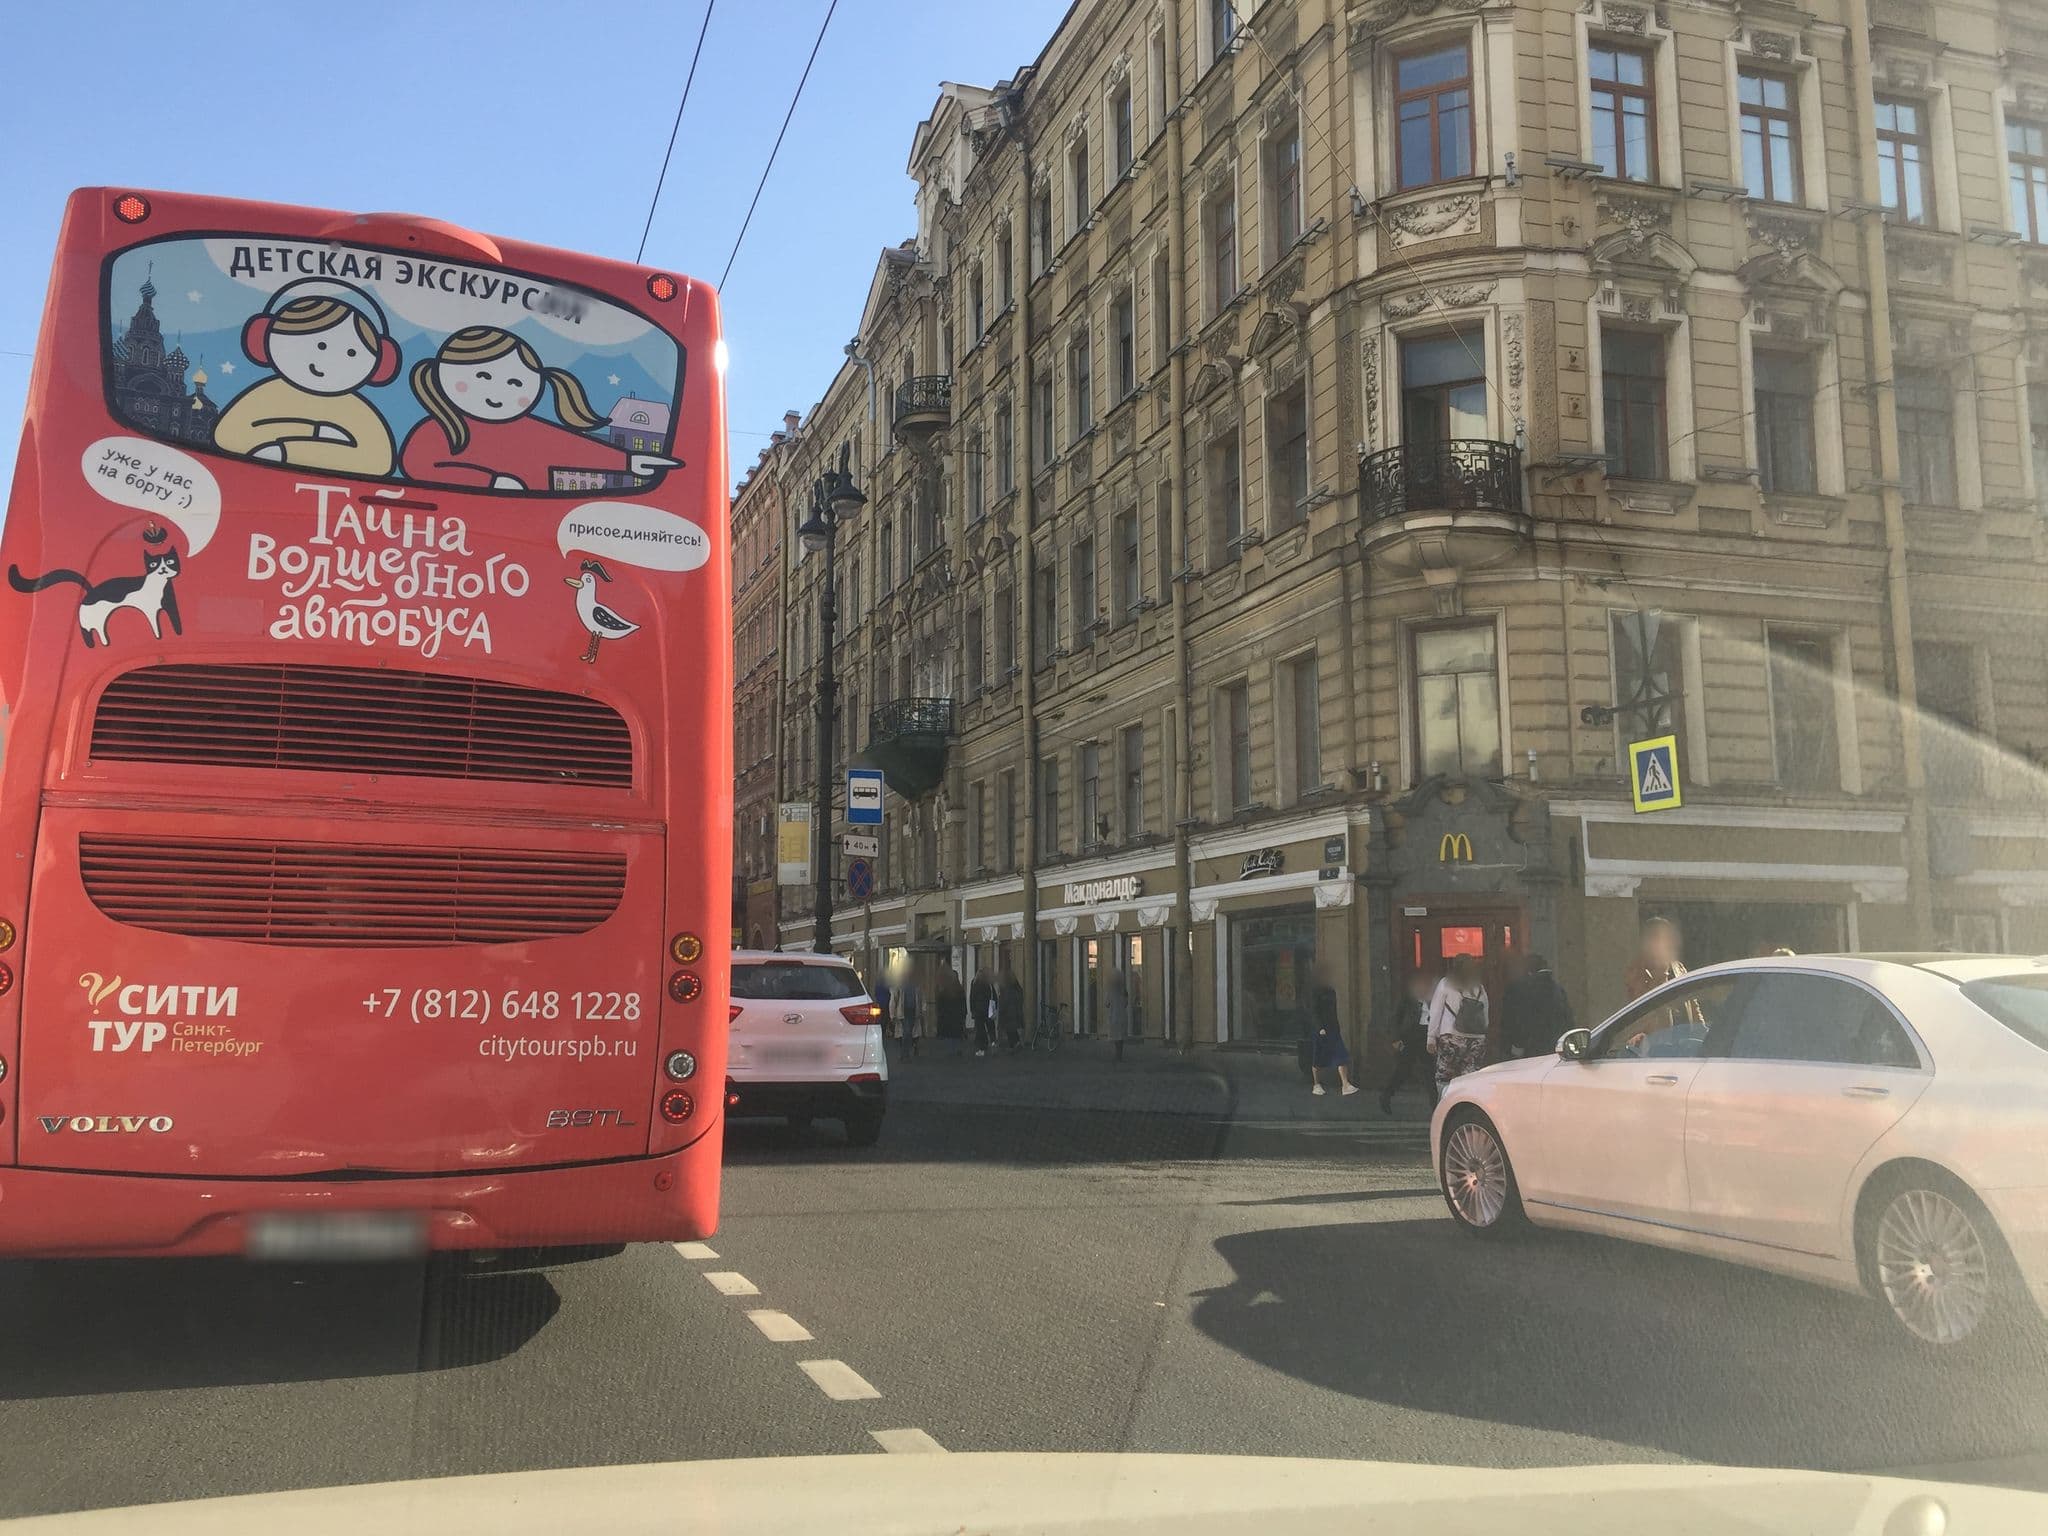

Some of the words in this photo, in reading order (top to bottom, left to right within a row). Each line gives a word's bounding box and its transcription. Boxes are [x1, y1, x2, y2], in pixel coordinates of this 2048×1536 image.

[230, 246, 382, 281] ДЕТСКАЯ
[395, 260, 582, 325] ЭКСКУРС
[97, 464, 118, 479] на
[125, 473, 173, 501] борту
[102, 449, 141, 470] уже
[144, 465, 158, 477] у
[163, 471, 193, 490] нас
[569, 522, 702, 547] присоединяйтесь!
[1064, 876, 1138, 905] Макдоналдс
[118, 984, 238, 1017] СИТИ
[362, 988, 401, 1018] +7
[410, 988, 491, 1024] (812)
[502, 990, 560, 1020] 648
[571, 991, 641, 1021] 1228
[88, 1020, 167, 1053] ТУР
[172, 1021, 231, 1037] Санкт-
[171, 1037, 264, 1057] Петербург
[479, 1034, 637, 1062] citytourspb.ru
[36, 1115, 173, 1133] VOLVO
